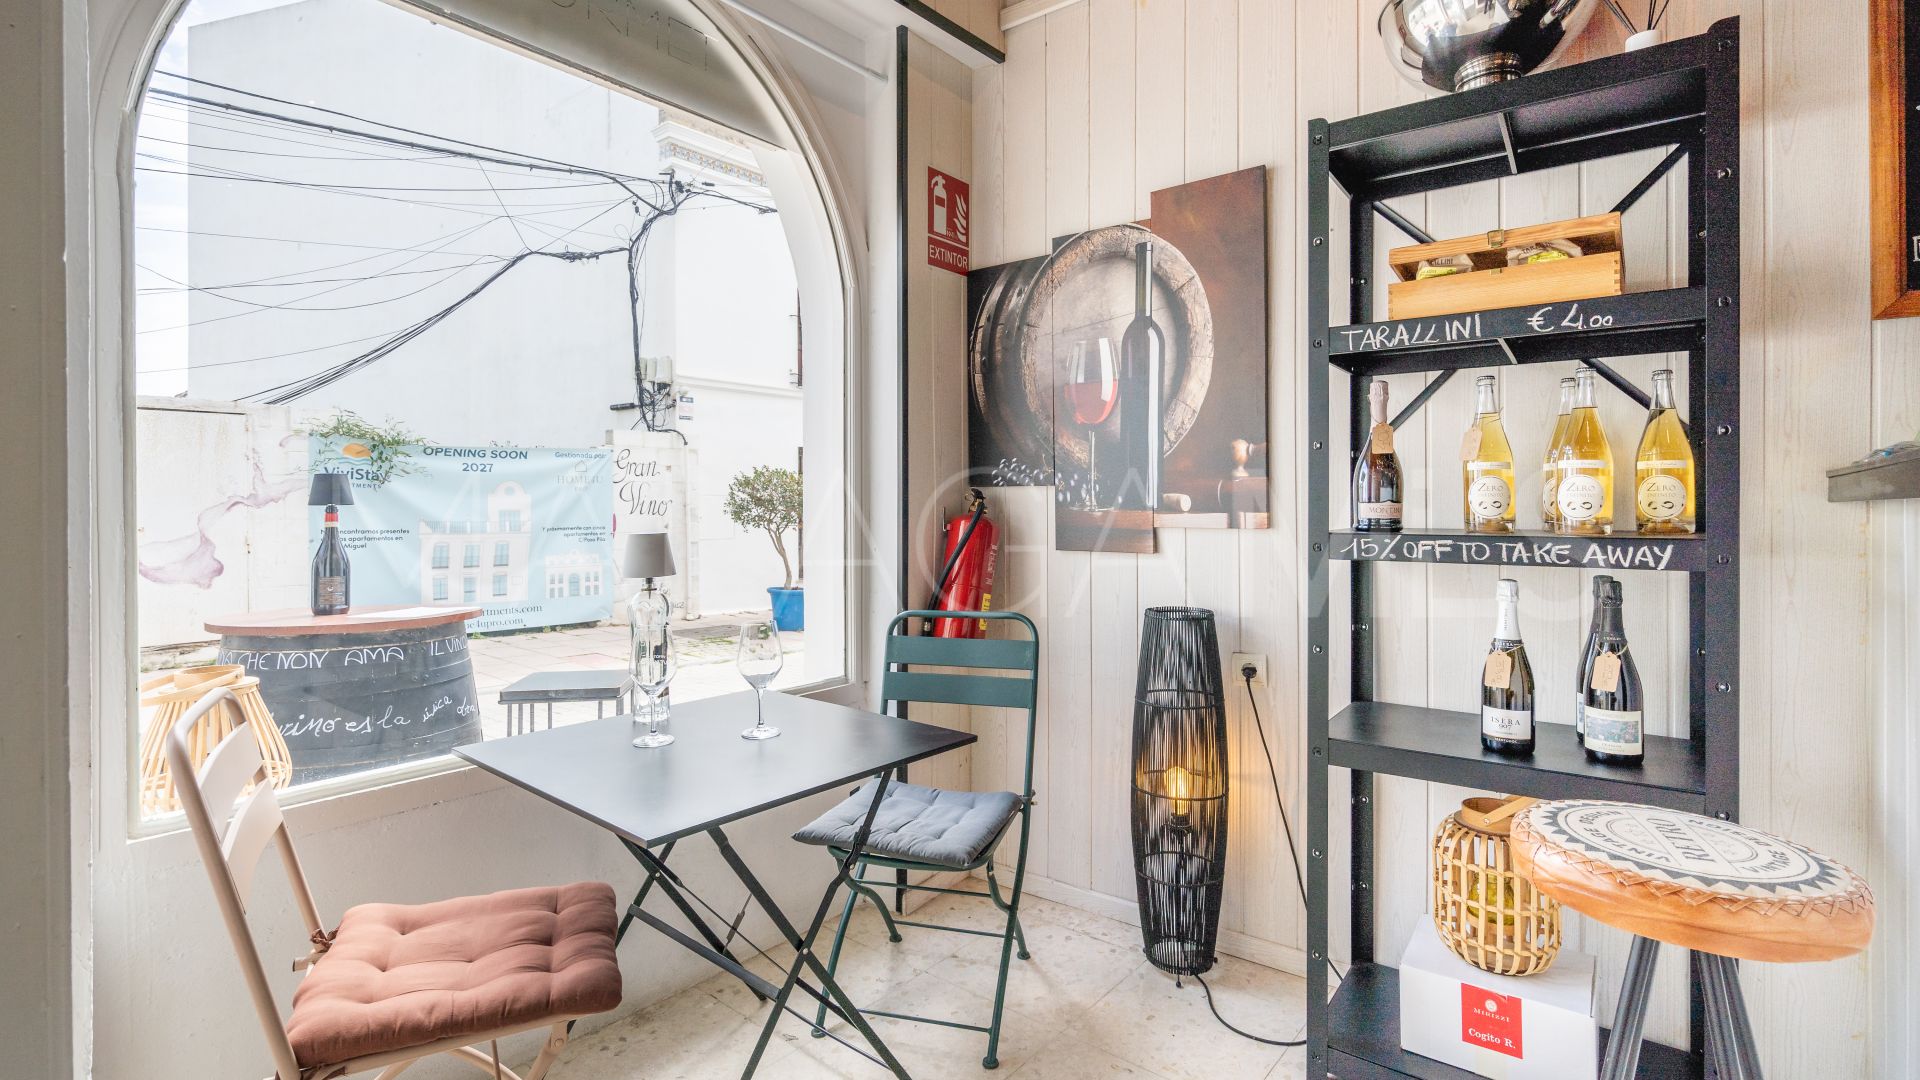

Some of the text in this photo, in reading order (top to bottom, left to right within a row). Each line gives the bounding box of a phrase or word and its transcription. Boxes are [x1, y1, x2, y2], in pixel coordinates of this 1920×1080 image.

[929, 244, 968, 270] EXTINTOR
[1340, 303, 1613, 351] TARALLINI € 4.00
[423, 446, 528, 460] OPENING SOON
[613, 448, 660, 484] Gran
[461, 462, 494, 473] 2027
[619, 480, 673, 517] Vino
[343, 542, 367, 550] Miguel
[1340, 533, 1675, 571] 15% OFF TO TAKE AWAY
[238, 652, 271, 670] CHE
[277, 651, 329, 670] NON
[344, 646, 404, 667] AMA
[430, 640, 445, 656] IL
[345, 715, 372, 734] es
[377, 705, 411, 729] la
[1491, 716, 1521, 726] ISERA
[1583, 826, 1672, 863] VINTAGE
[1646, 817, 1717, 863] RETRO
[1741, 849, 1791, 873] VINTAGE
[1473, 1007, 1510, 1023] MIRIZZI
[1468, 1027, 1516, 1049] Cogito R.
